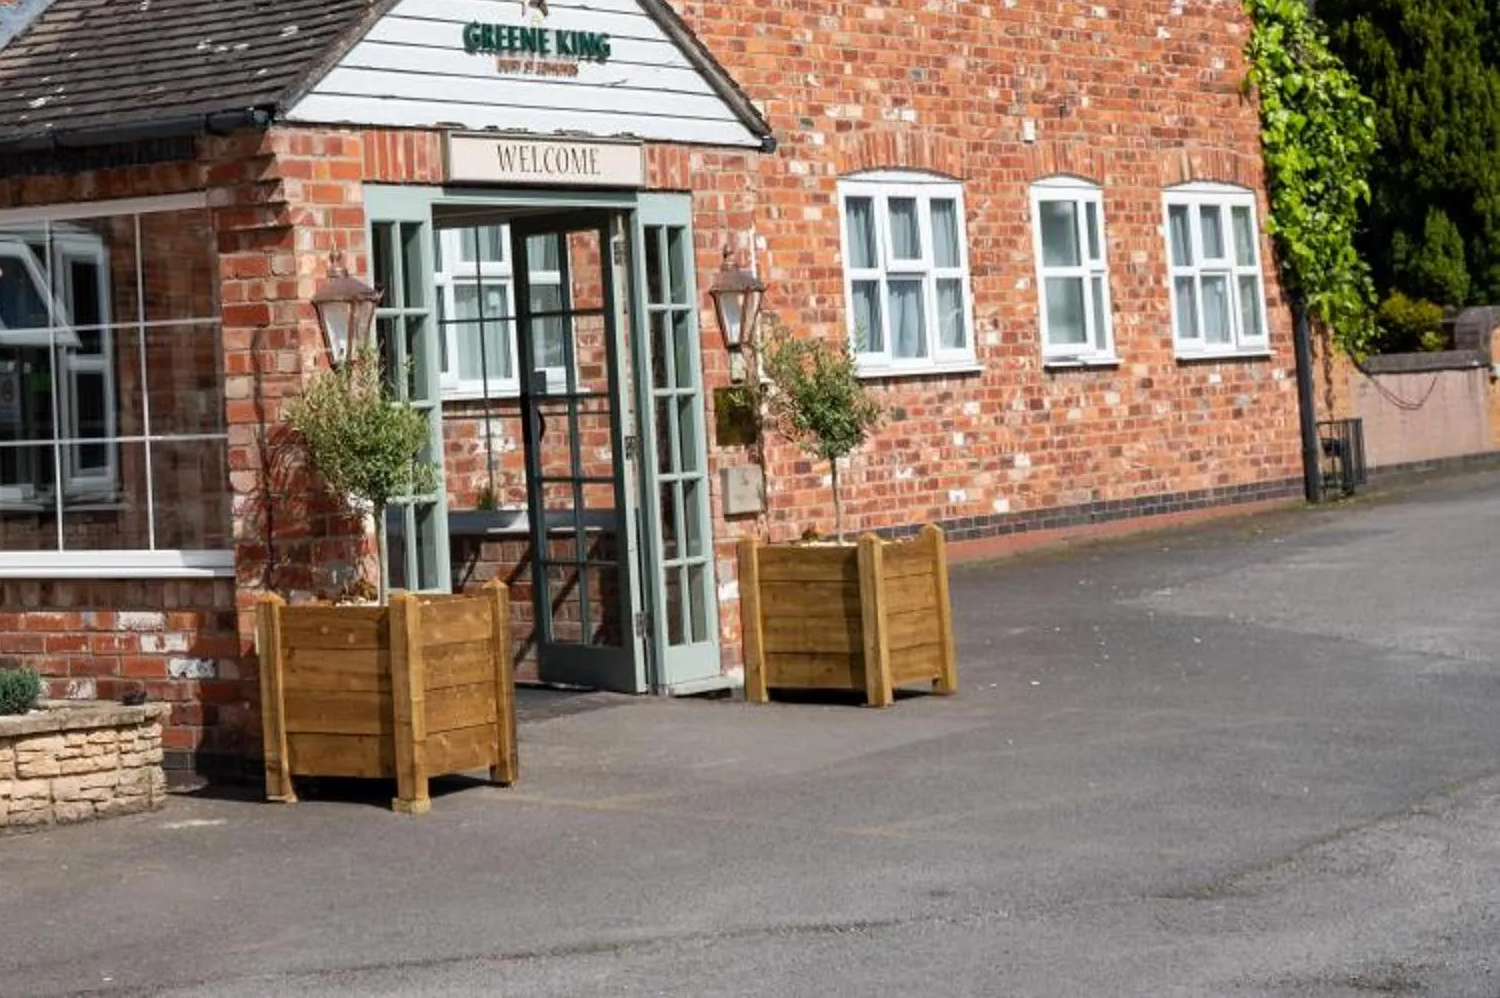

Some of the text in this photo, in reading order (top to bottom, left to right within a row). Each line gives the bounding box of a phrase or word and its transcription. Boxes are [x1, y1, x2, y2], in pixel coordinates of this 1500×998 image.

[463, 22, 611, 59] GREENE KING
[497, 144, 601, 175] WELCOME
